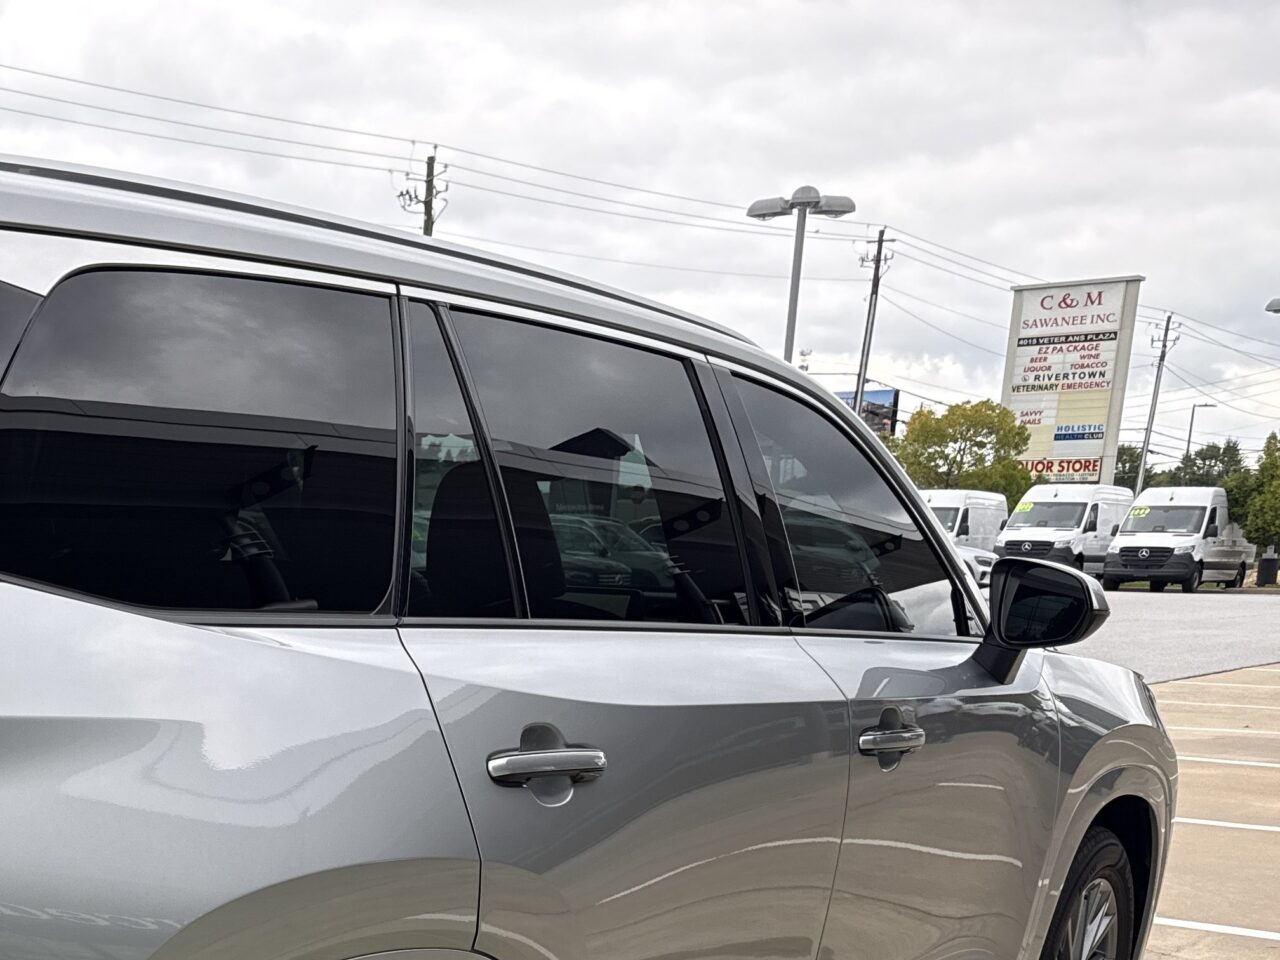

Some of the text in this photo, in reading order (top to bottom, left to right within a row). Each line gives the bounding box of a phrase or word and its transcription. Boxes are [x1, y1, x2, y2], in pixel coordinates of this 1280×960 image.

[1040, 290, 1105, 310] C & M
[1021, 313, 1118, 330] SAWANEE INC.
[1087, 332, 1116, 341] PLAZA
[1037, 346, 1051, 355] EZ
[1029, 356, 1048, 364] BEER
[1079, 353, 1101, 361] WINE
[1023, 365, 1053, 373] LIQUOR
[1070, 361, 1108, 370] TOBACCO
[1033, 370, 1107, 382] RIVERTOWN
[1011, 380, 1112, 393] VETERINARY EMERGENCY
[1020, 410, 1044, 418] SAVVY
[1020, 418, 1042, 426] NAILS
[1056, 424, 1105, 432] HOLISTIC
[1057, 460, 1100, 473] STORE
